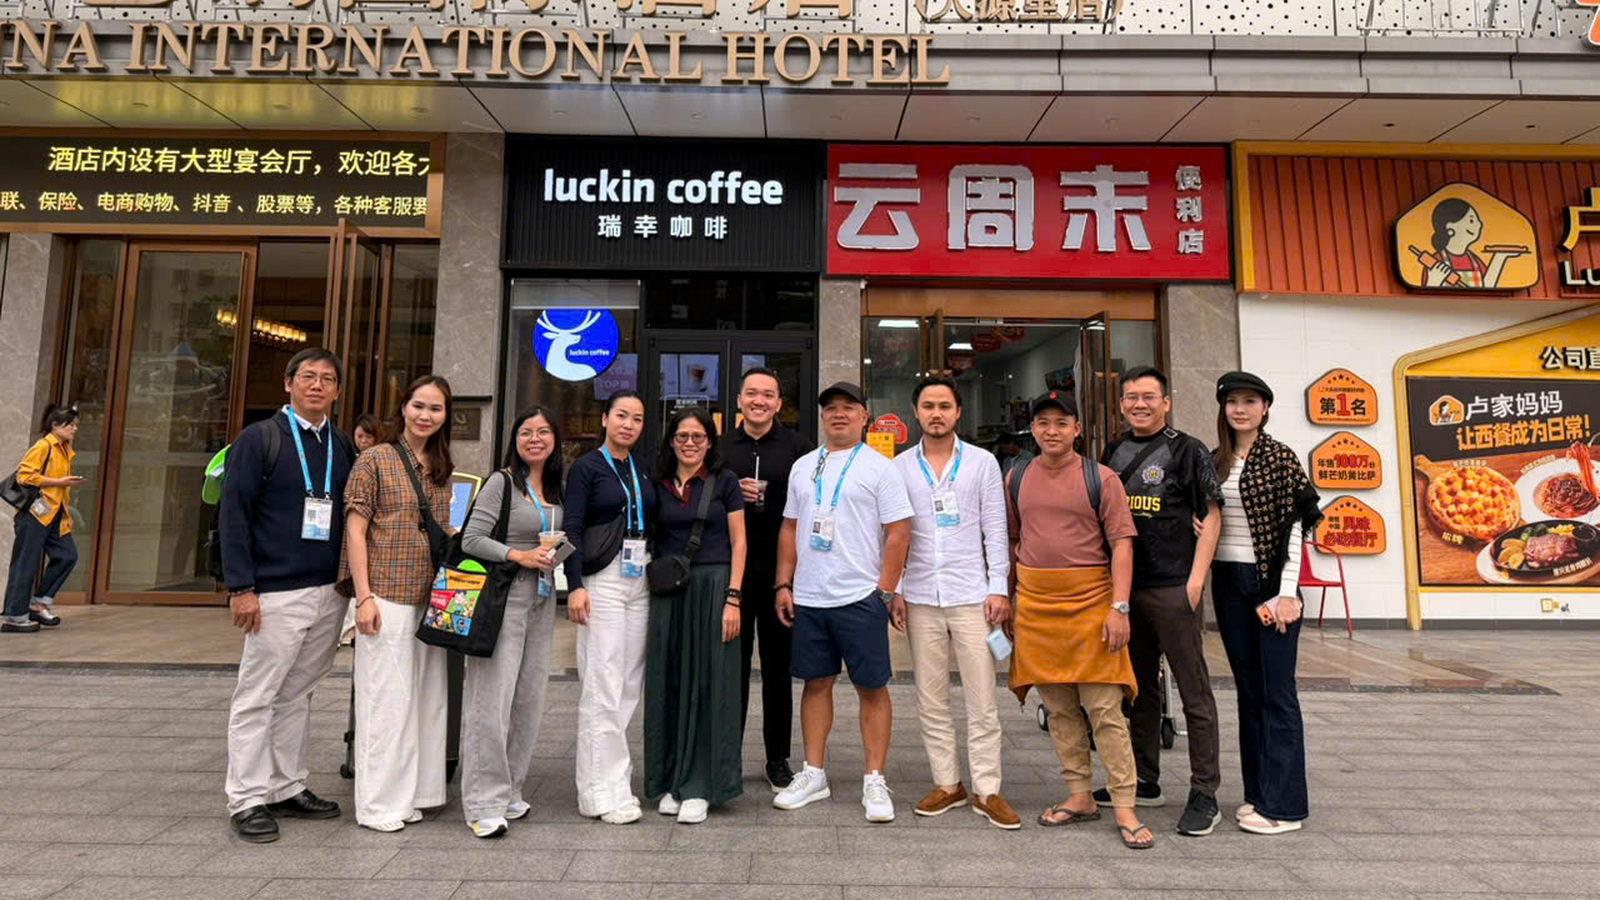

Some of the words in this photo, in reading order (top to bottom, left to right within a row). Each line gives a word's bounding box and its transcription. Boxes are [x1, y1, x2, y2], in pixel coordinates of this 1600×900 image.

[127, 23, 702, 82] INTERNATIONAL
[721, 33, 950, 86] HOTEL
[544, 168, 655, 202] luckin
[667, 171, 783, 205] coffee
[834, 163, 1151, 252] 云周末
[1175, 165, 1204, 254] 便利店
[598, 214, 728, 240] 瑞幸咖啡
[1320, 393, 1366, 416] 第1名
[1465, 390, 1563, 420] 卢家妈妈
[1456, 414, 1591, 451] 让西餐成为日常!
